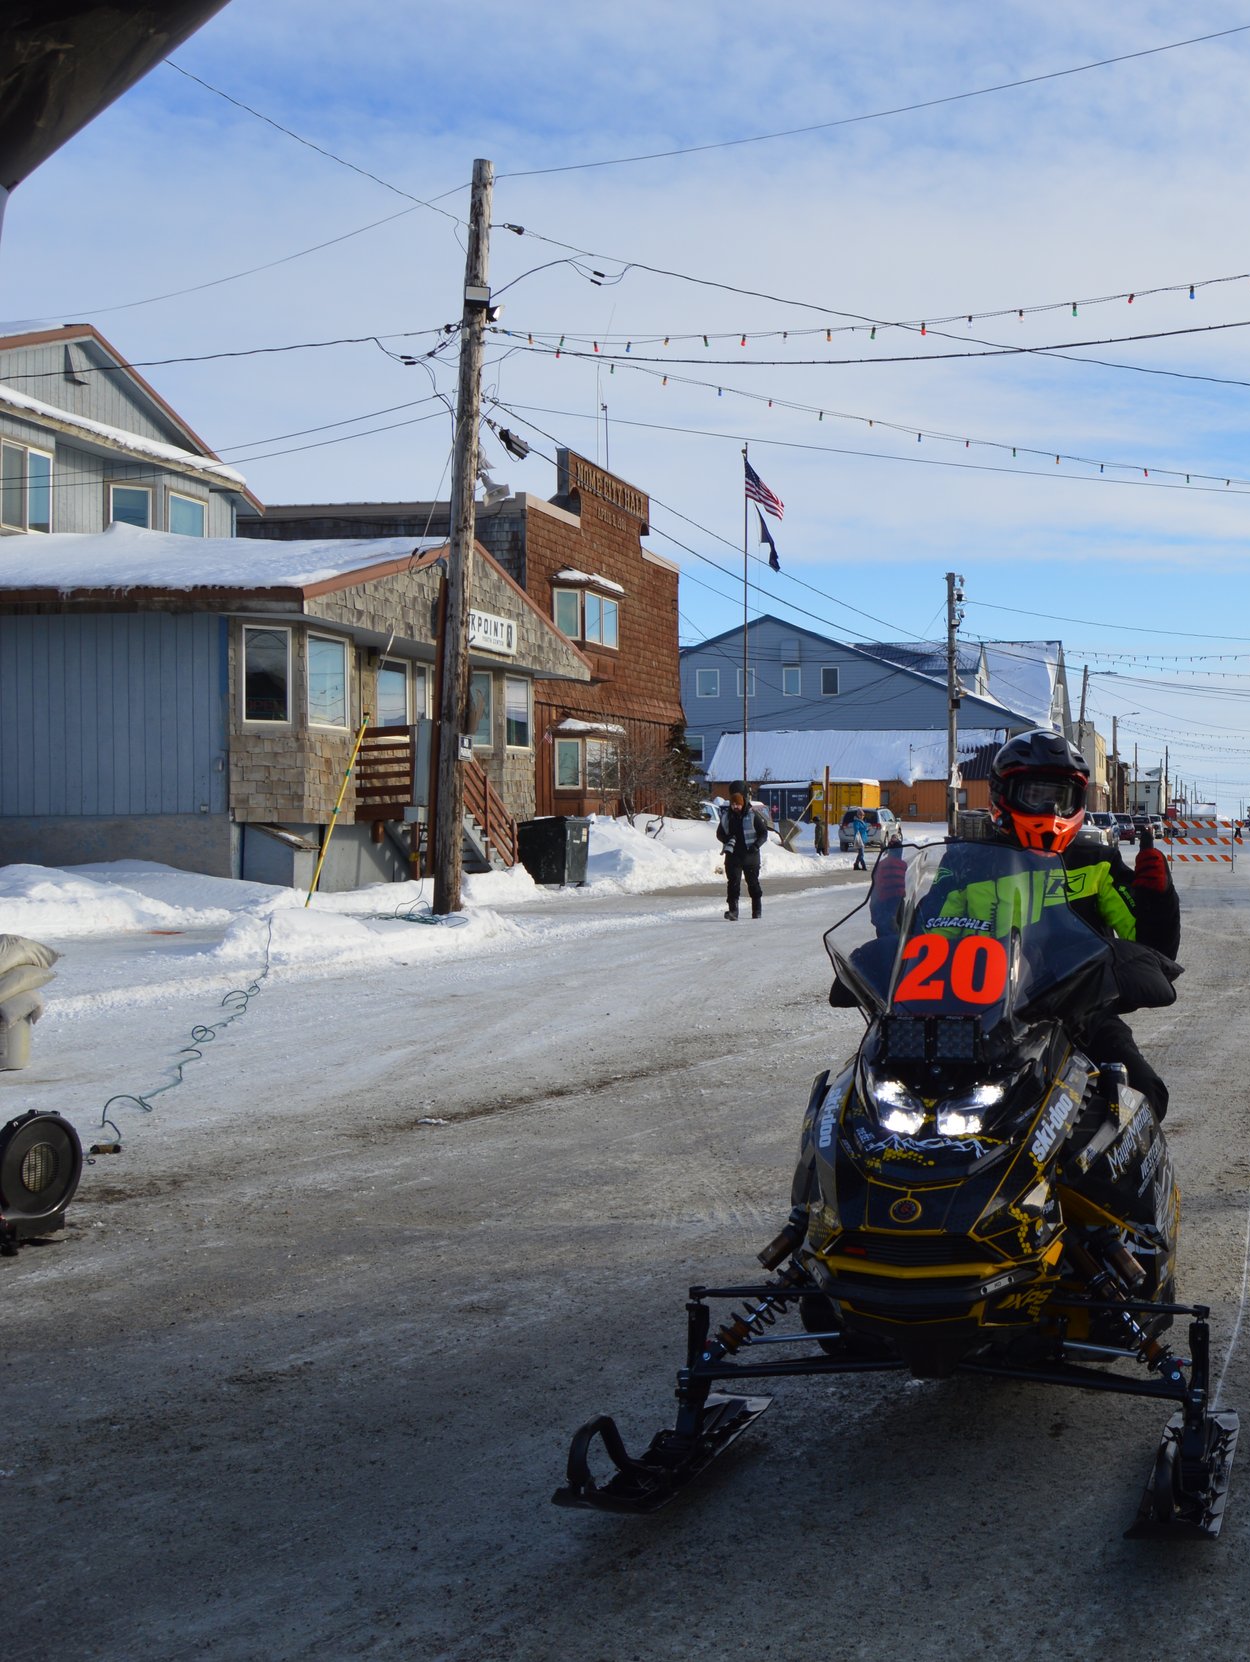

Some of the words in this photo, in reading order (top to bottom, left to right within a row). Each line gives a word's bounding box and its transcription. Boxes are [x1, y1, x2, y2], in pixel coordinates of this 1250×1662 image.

[576, 462, 602, 498] NOME
[602, 476, 623, 505] CITY
[623, 488, 644, 519] HALL
[925, 916, 992, 930] SCHACHLE
[893, 933, 1008, 1005] 20
[819, 1087, 842, 1148] ski-doo
[1031, 1093, 1073, 1162] ski-doo
